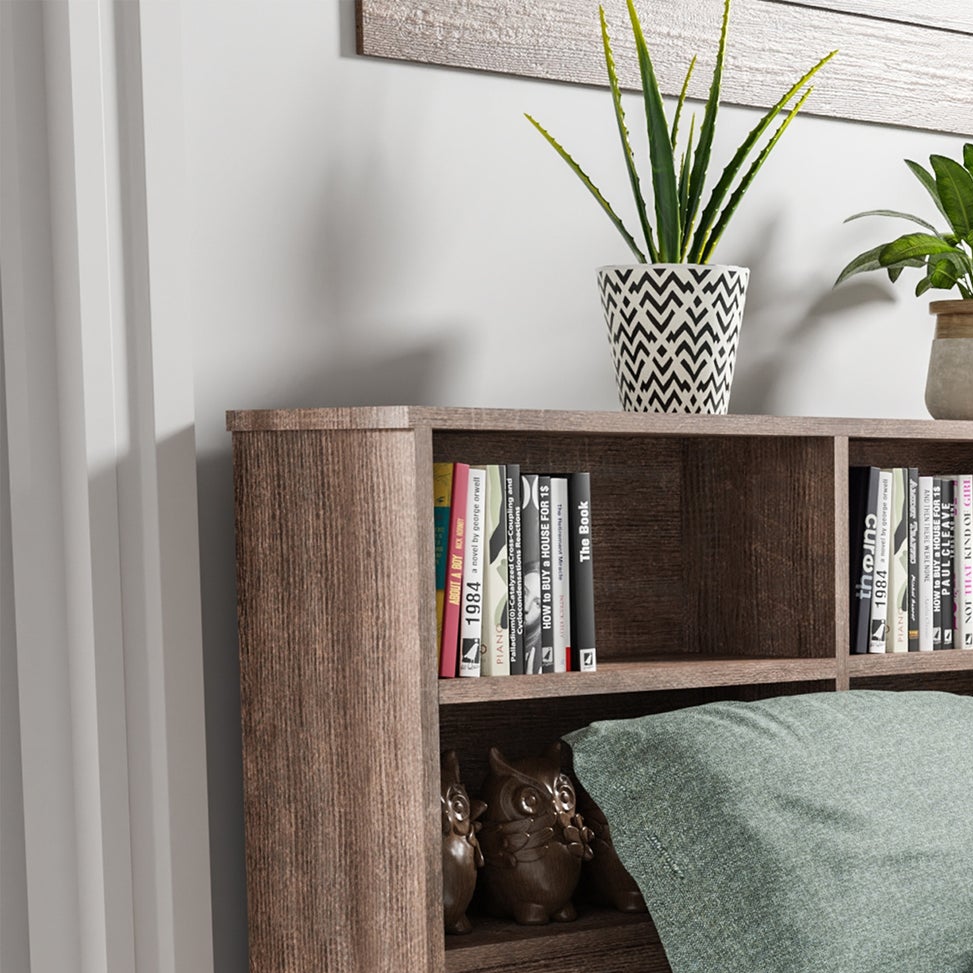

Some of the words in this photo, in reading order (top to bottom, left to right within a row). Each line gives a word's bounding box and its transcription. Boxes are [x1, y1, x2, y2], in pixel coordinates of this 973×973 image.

[472, 476, 480, 502] orwell
[540, 485, 549, 498] 1$
[472, 504, 480, 531] george
[541, 500, 550, 521] FOR
[578, 501, 590, 534] Book
[964, 510, 971, 526] OF
[472, 533, 480, 542] by
[507, 497, 515, 562] Cross-Coupling
[542, 524, 550, 558] HOUSE
[880, 528, 888, 536] by
[942, 502, 950, 556] CLEAVE
[470, 545, 478, 566] novel
[580, 538, 590, 562] The
[964, 528, 972, 560] KIND
[452, 554, 464, 570] BOY
[542, 570, 551, 590] BUY
[875, 570, 887, 608] 1984
[934, 580, 940, 588] to
[942, 560, 950, 596] PAUL
[964, 564, 972, 596] THAT
[449, 580, 462, 606] ABOUT
[465, 582, 481, 625] 1984
[514, 550, 523, 634] Cyclocondensations
[543, 593, 550, 602] to
[508, 564, 516, 662] Palladium(0)-Catalyzed
[543, 605, 552, 629] HOW
[964, 600, 972, 624] NOT
[496, 624, 504, 664] PIANO
